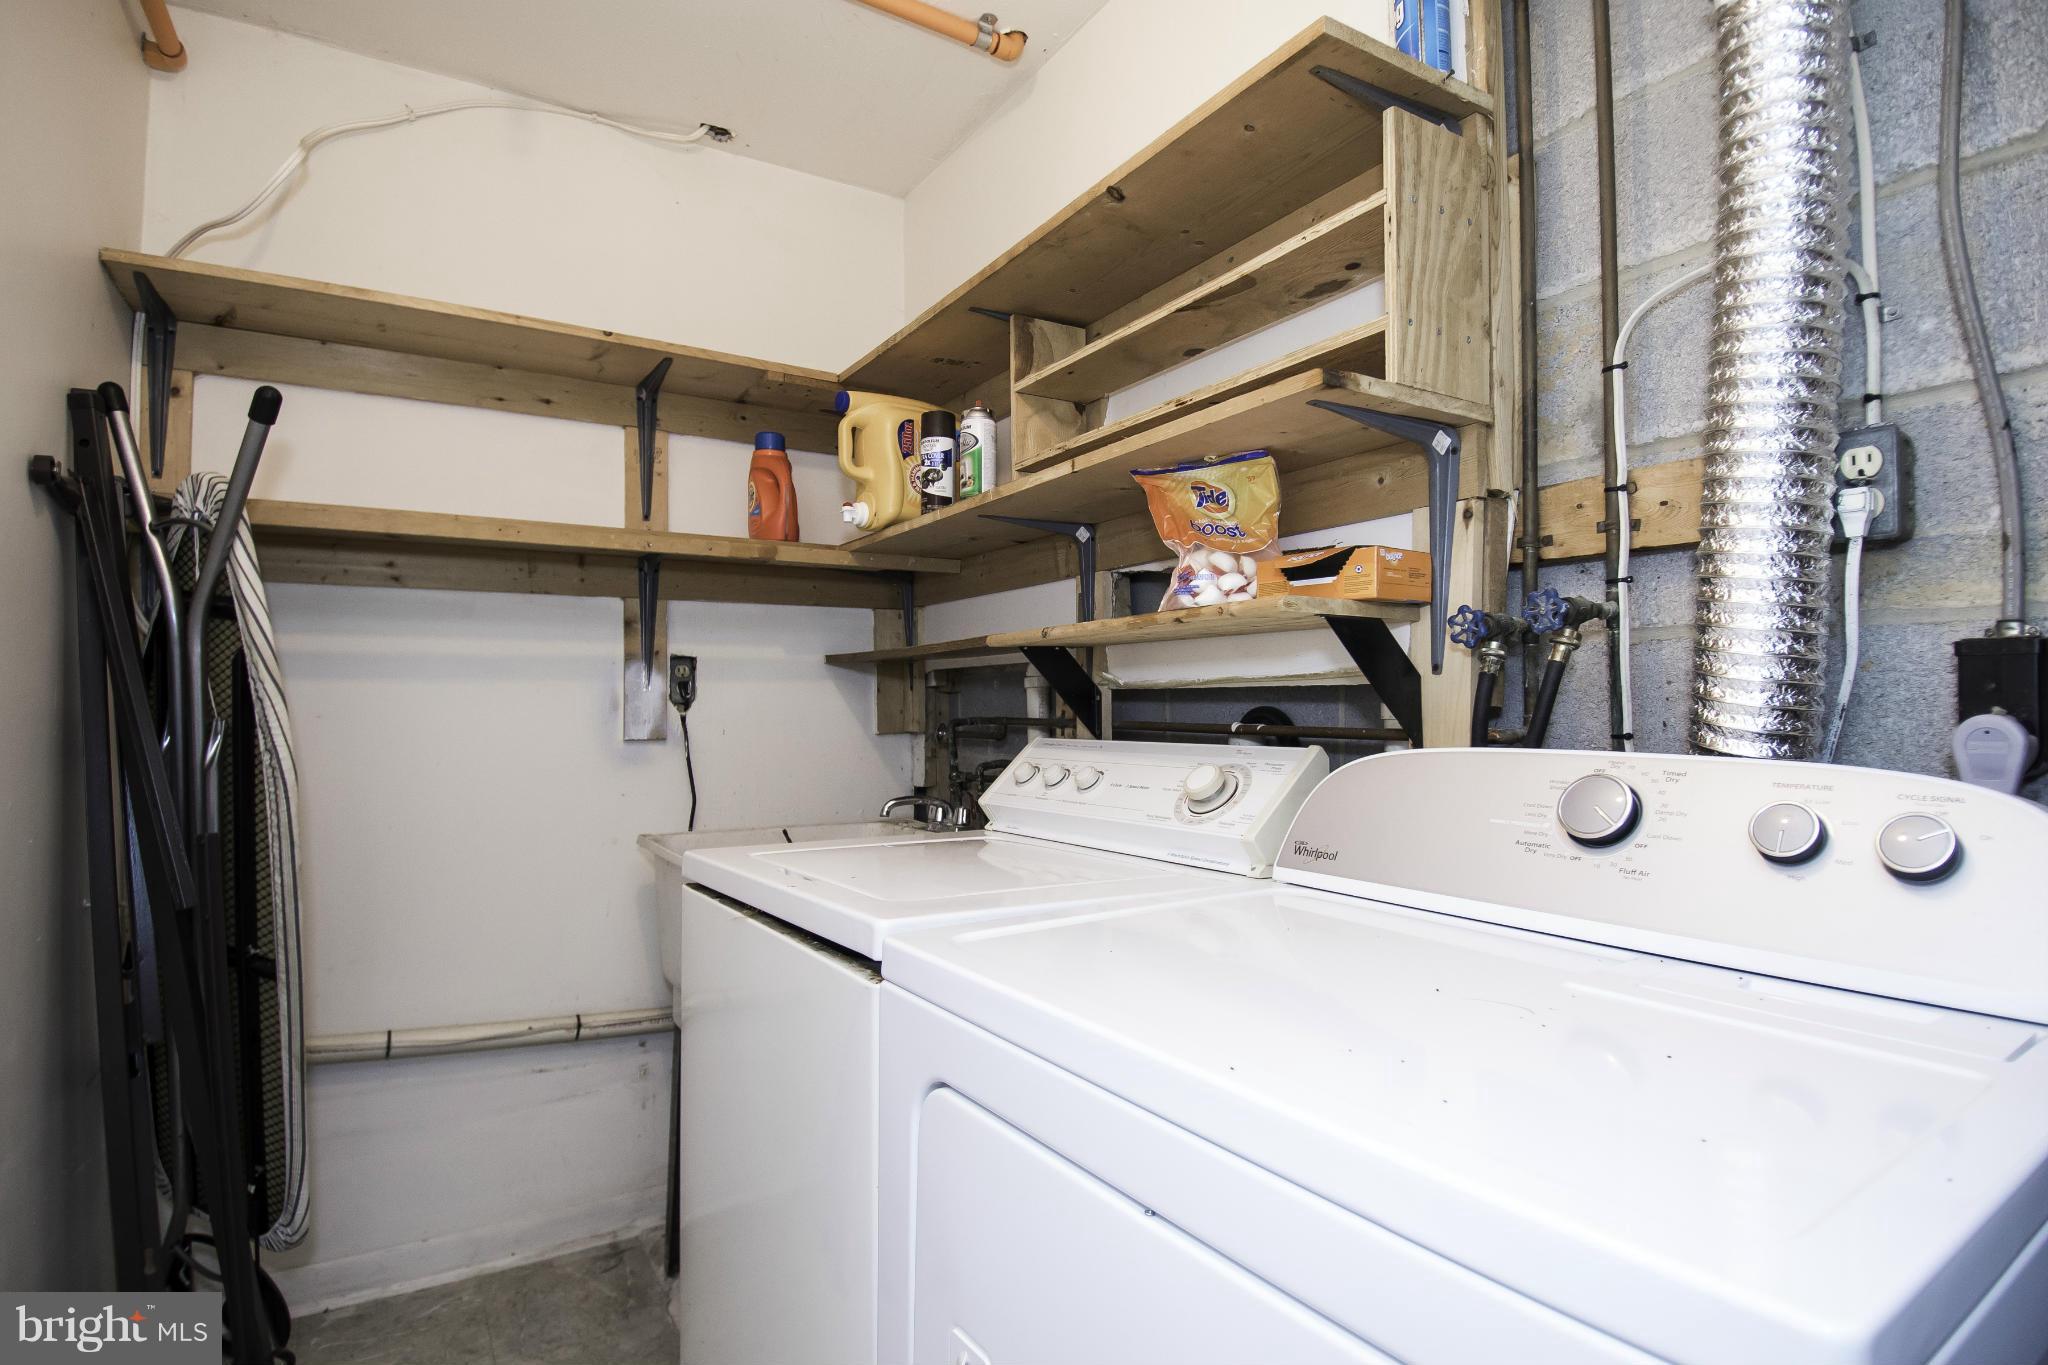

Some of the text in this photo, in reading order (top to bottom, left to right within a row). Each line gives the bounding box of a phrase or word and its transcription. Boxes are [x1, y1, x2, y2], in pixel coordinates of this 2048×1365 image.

[1191, 486, 1227, 507] Tide
[1190, 519, 1246, 538] boost
[1663, 769, 1688, 777] Timed
[1772, 781, 1834, 792] TEMPERATURE
[1896, 793, 1967, 804] CYCLE SIGNAL
[1515, 839, 1552, 850] Automatic
[1294, 844, 1339, 862] Whirlpool
[1524, 846, 1538, 855] Dry
[1618, 867, 1637, 876] Fluff
